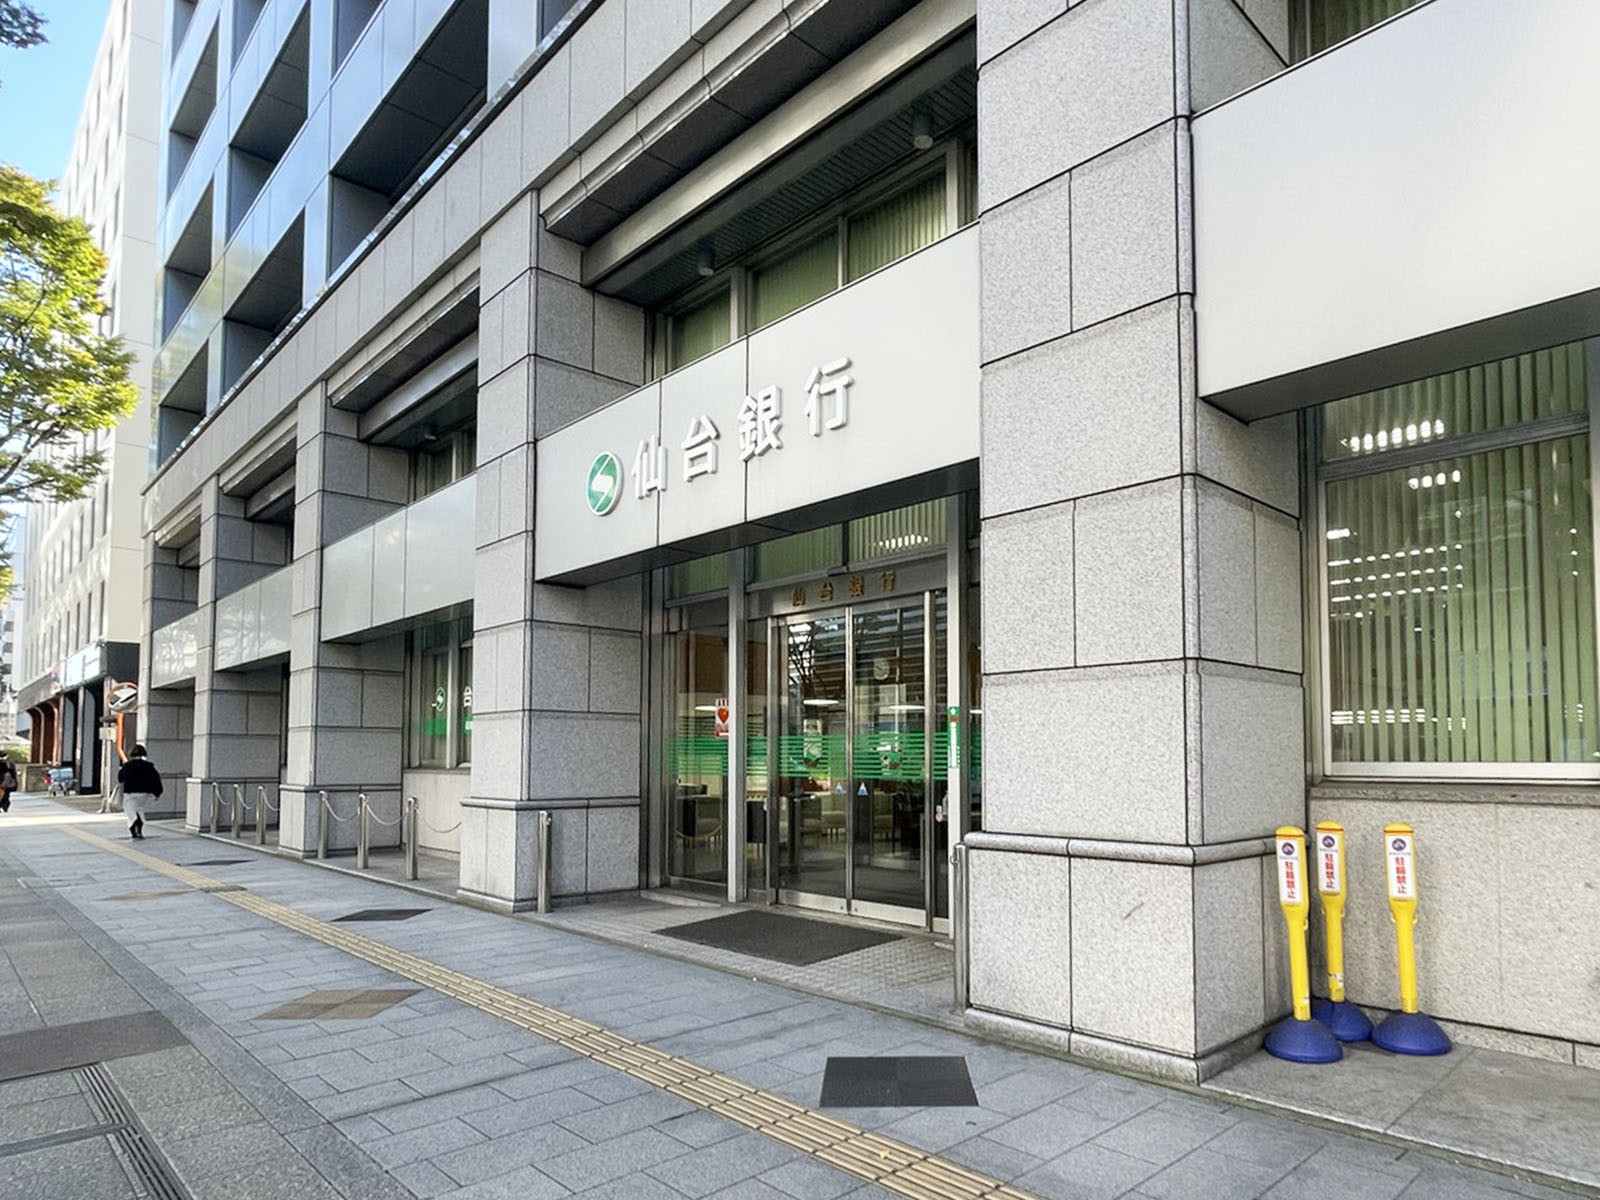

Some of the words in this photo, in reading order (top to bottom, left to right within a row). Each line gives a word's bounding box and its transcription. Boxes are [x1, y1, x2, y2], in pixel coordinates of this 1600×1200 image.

[631, 356, 853, 500] 仙台銀行
[792, 568, 897, 607] 仙台銀行
